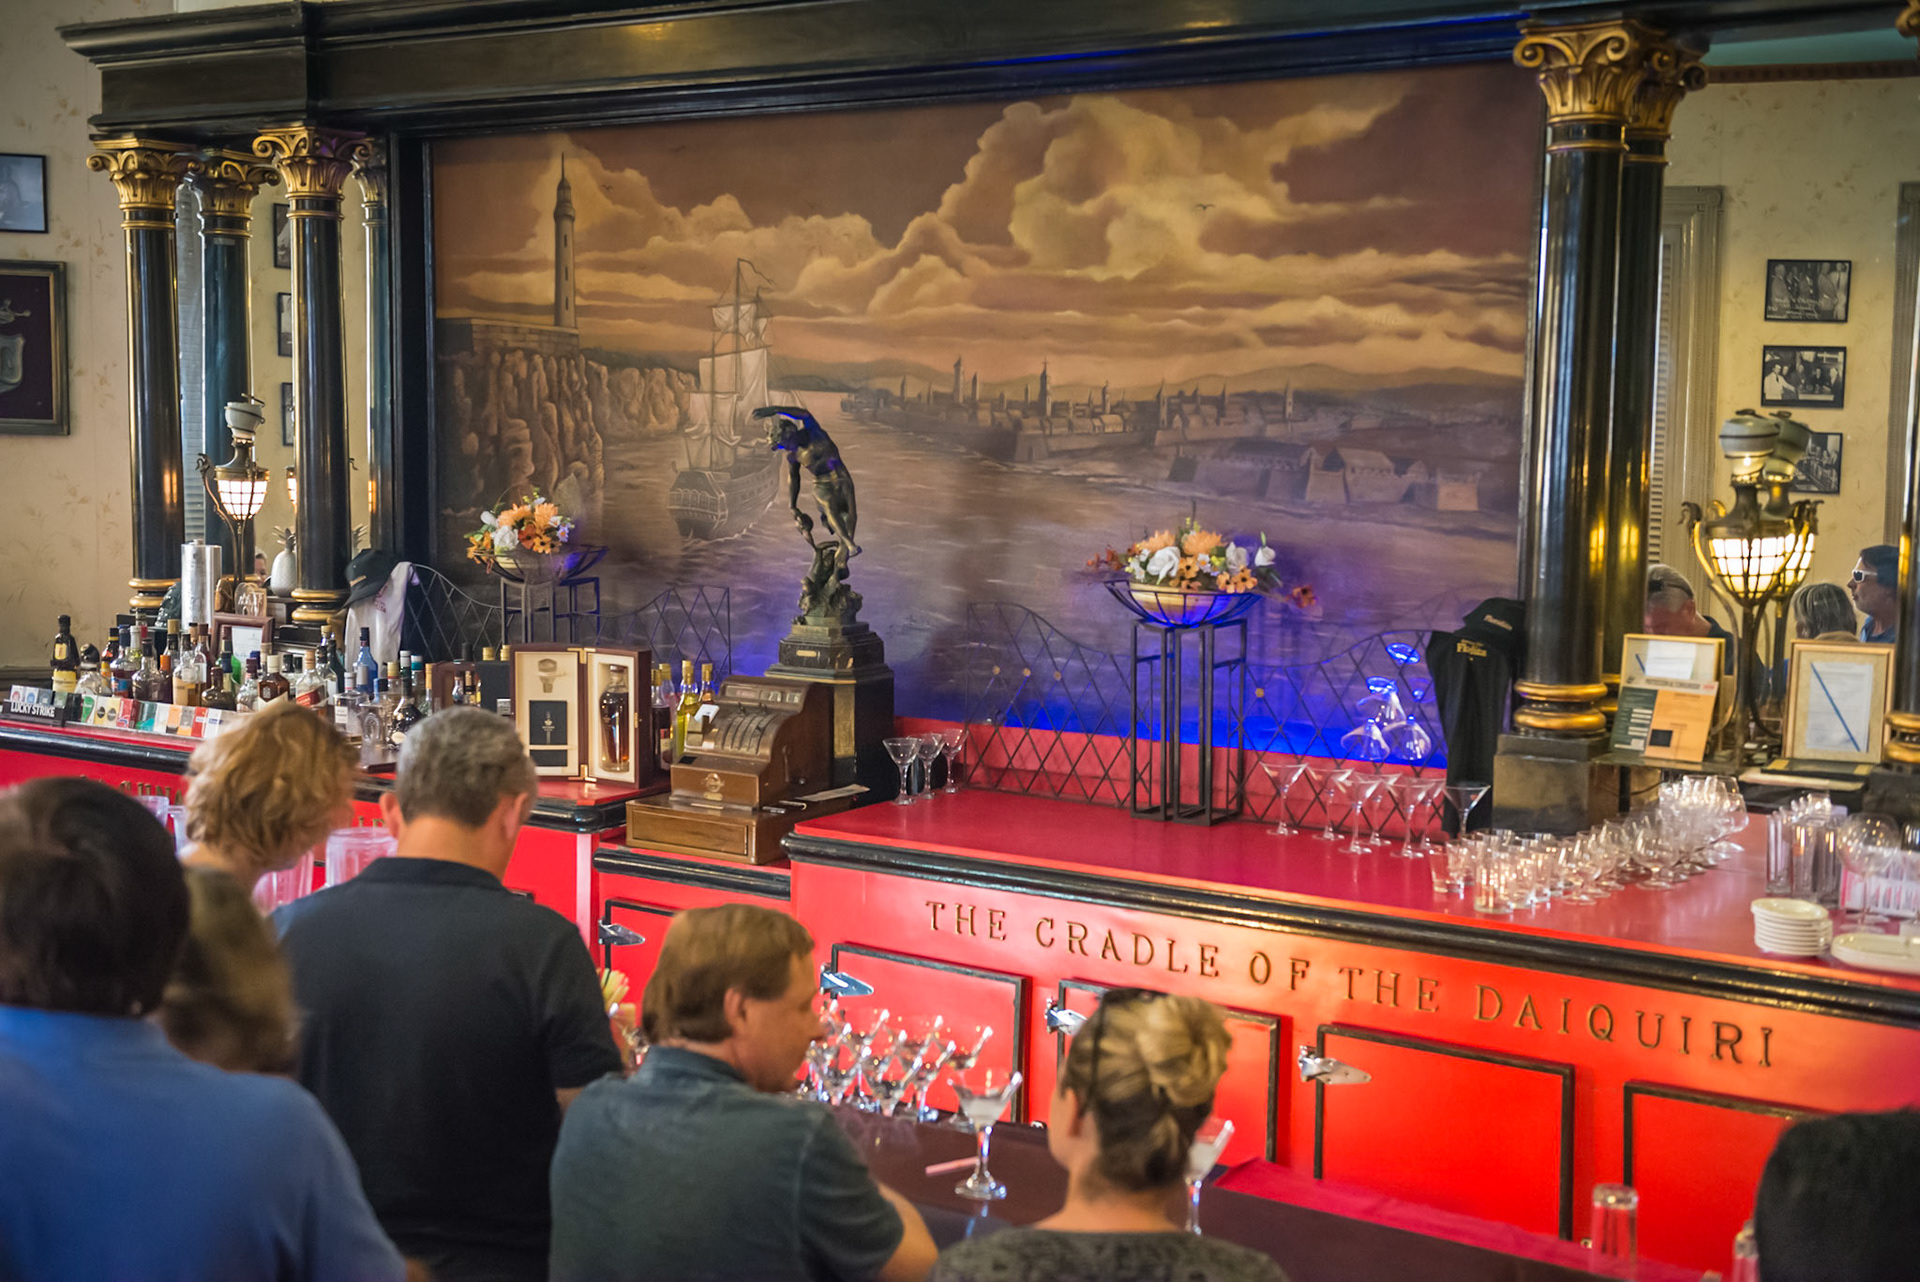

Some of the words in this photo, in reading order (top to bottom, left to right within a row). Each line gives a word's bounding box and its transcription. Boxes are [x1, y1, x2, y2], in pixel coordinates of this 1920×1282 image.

[11, 701, 33, 715] LUCKY
[32, 703, 55, 718] STRIKE
[926, 901, 1006, 942] THE
[1035, 917, 1219, 978] CRADLE
[1249, 951, 1310, 991] OF
[1338, 967, 1440, 1013] THE
[1473, 984, 1773, 1068] DAIQUIRI
